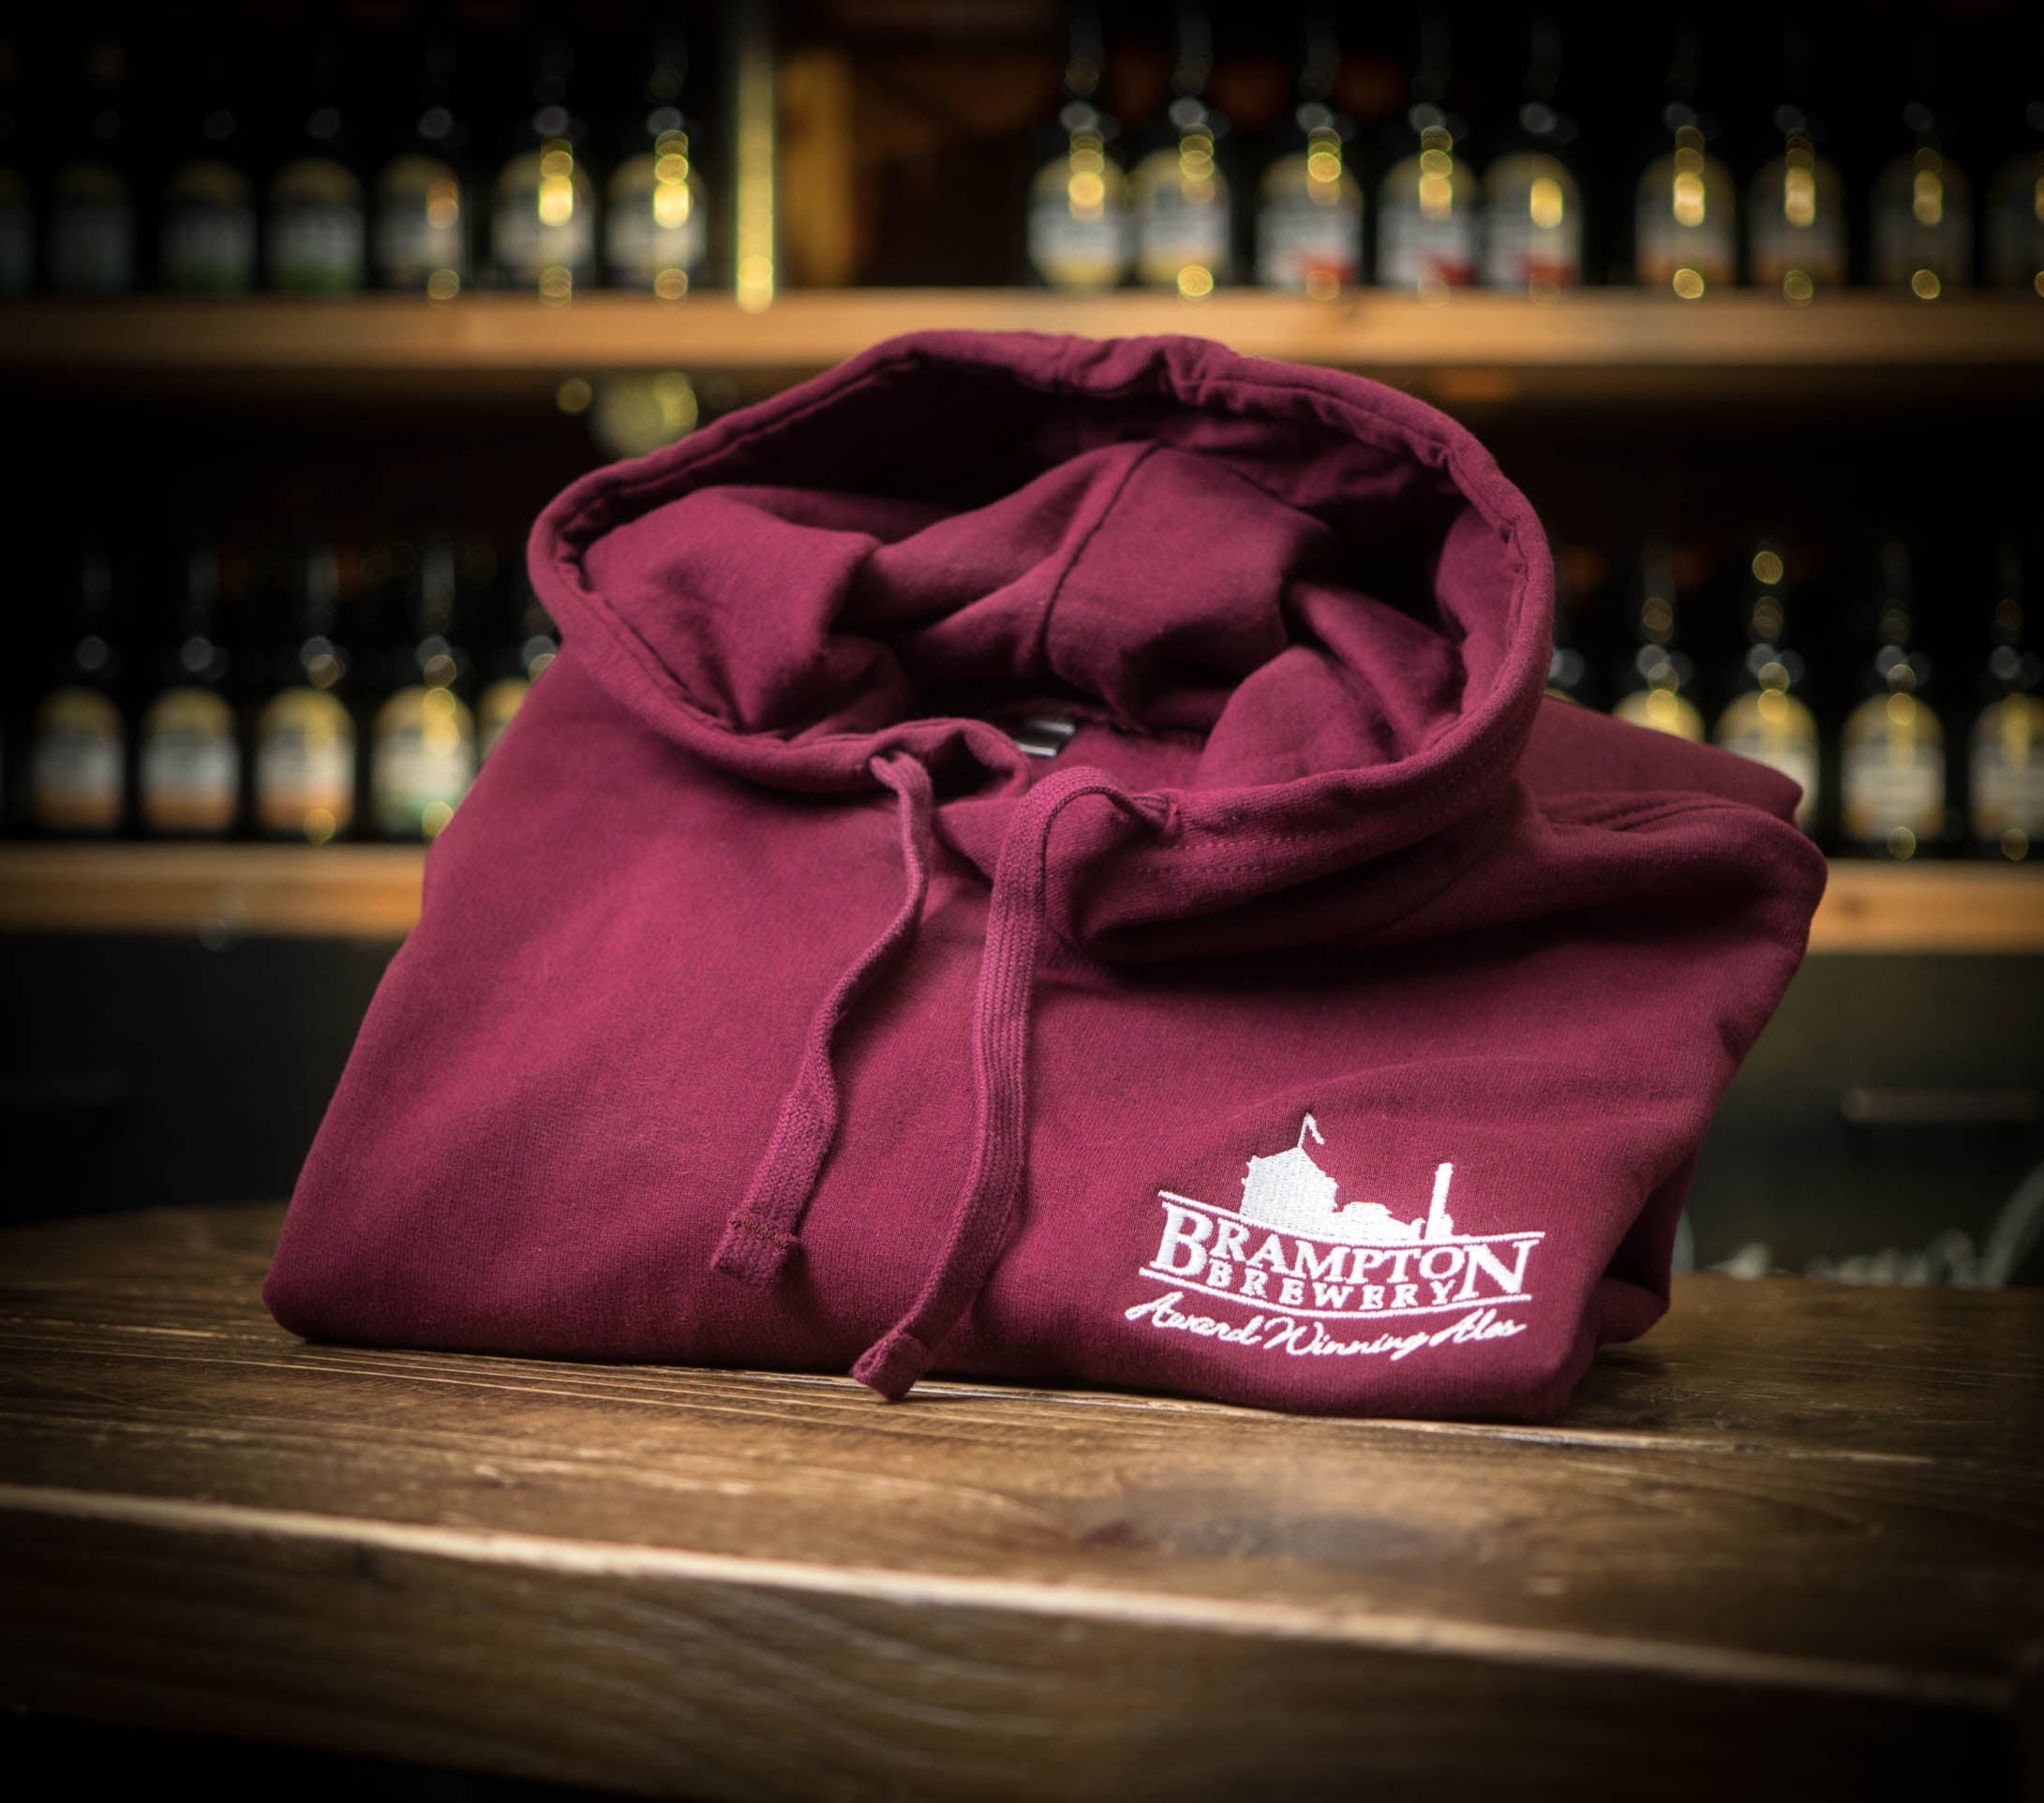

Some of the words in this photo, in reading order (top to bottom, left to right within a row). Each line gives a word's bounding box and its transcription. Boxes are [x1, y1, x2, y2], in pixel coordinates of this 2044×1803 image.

[1149, 1201, 1540, 1302] BRAMPTON
[1205, 1259, 1457, 1311] BREWERY
[1125, 1291, 1261, 1346] Award
[1263, 1316, 1431, 1361] Winning
[1428, 1309, 1527, 1347] Ales
